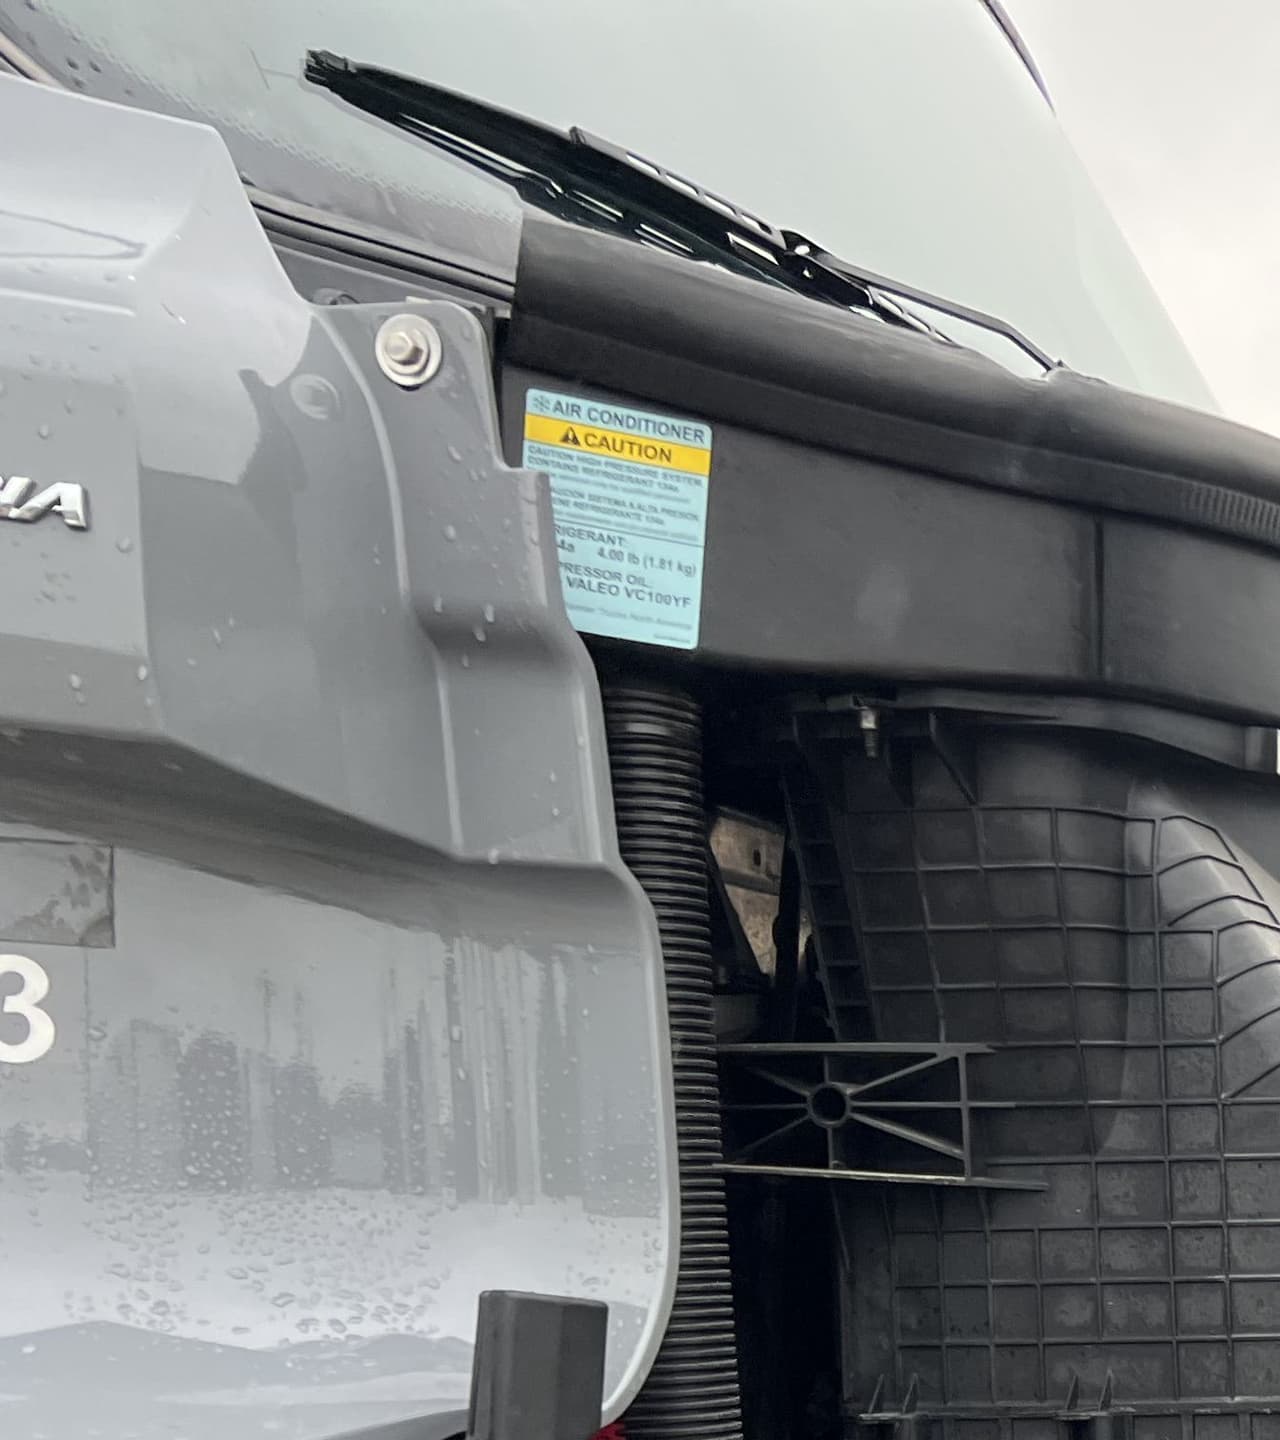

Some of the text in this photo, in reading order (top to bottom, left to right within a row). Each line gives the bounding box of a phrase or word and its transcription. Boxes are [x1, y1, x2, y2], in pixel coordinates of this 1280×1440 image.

[553, 400, 705, 443] AIR CONDITIONER
[584, 433, 673, 463] CAUTION
[559, 561, 622, 583] RESSOR
[566, 575, 692, 608] VALEO VC100YF
